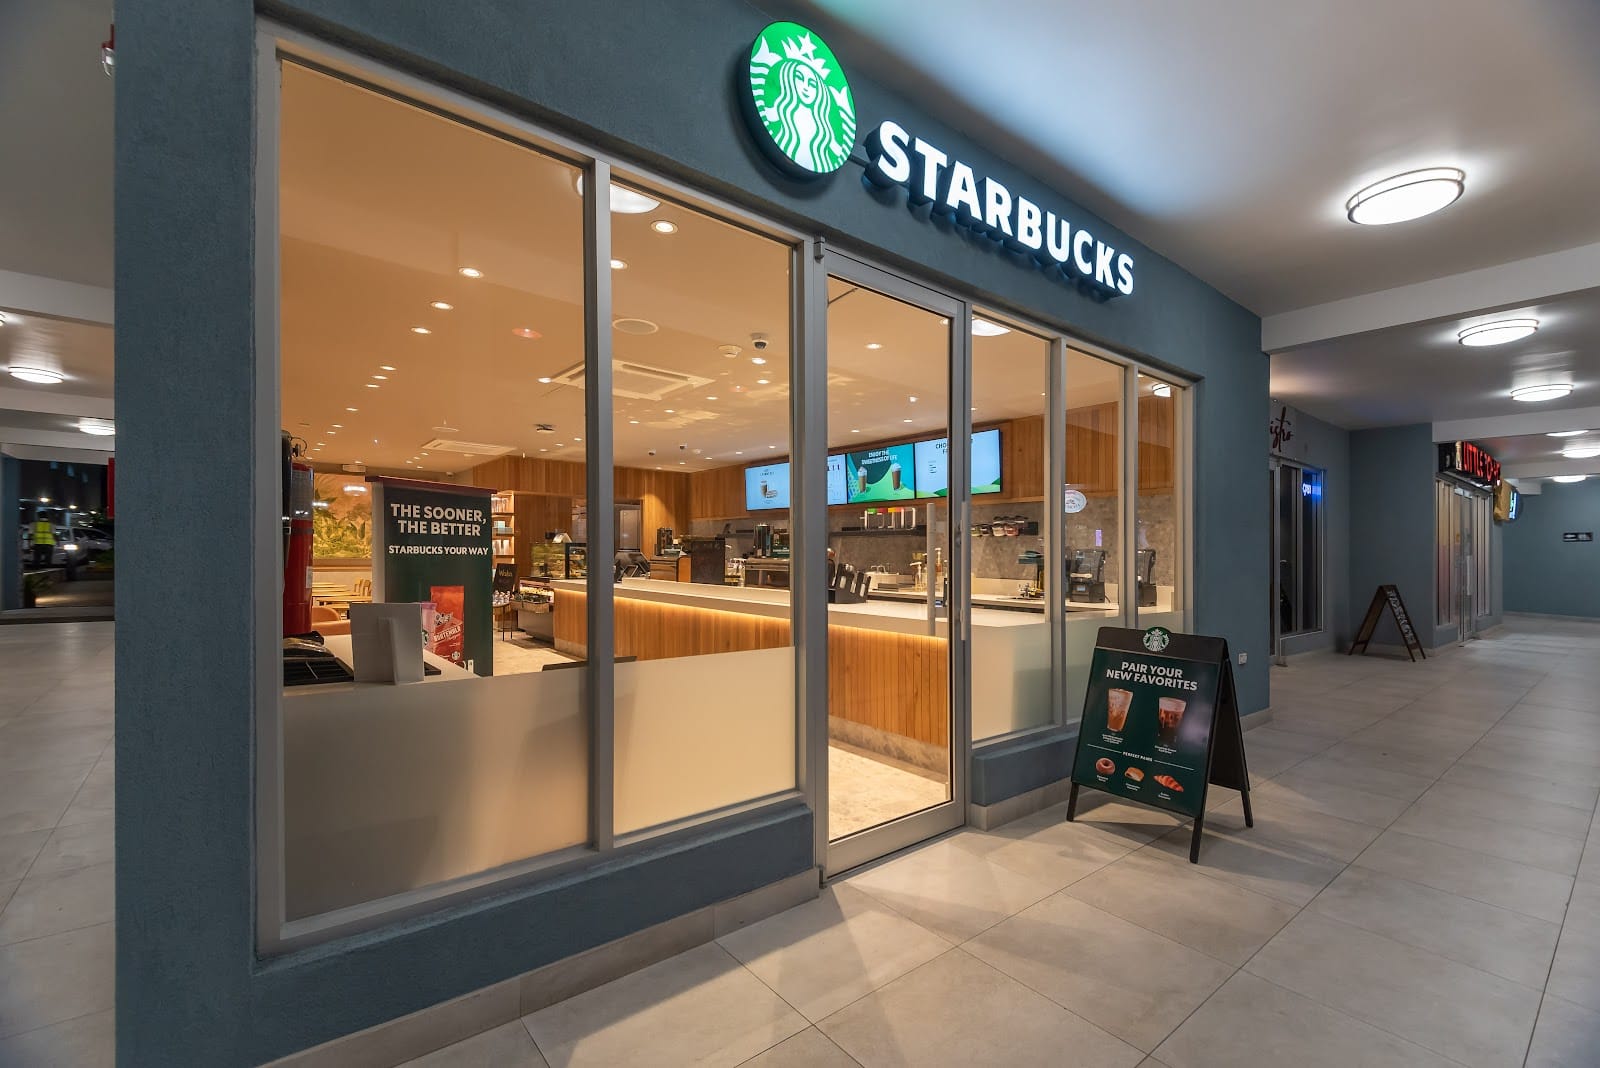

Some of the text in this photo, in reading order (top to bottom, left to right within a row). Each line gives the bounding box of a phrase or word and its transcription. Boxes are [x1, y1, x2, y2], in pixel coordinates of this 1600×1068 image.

[877, 120, 1134, 296] STARBUCKS
[1269, 406, 1294, 452] istro
[390, 503, 487, 524] THE SOONER,
[398, 519, 481, 537] THE BETTER
[388, 545, 489, 556] STARBUCKS YOUR WAY
[1106, 669, 1198, 691] NEW FAVORITES
[1121, 661, 1183, 679] PAIR YOUR
